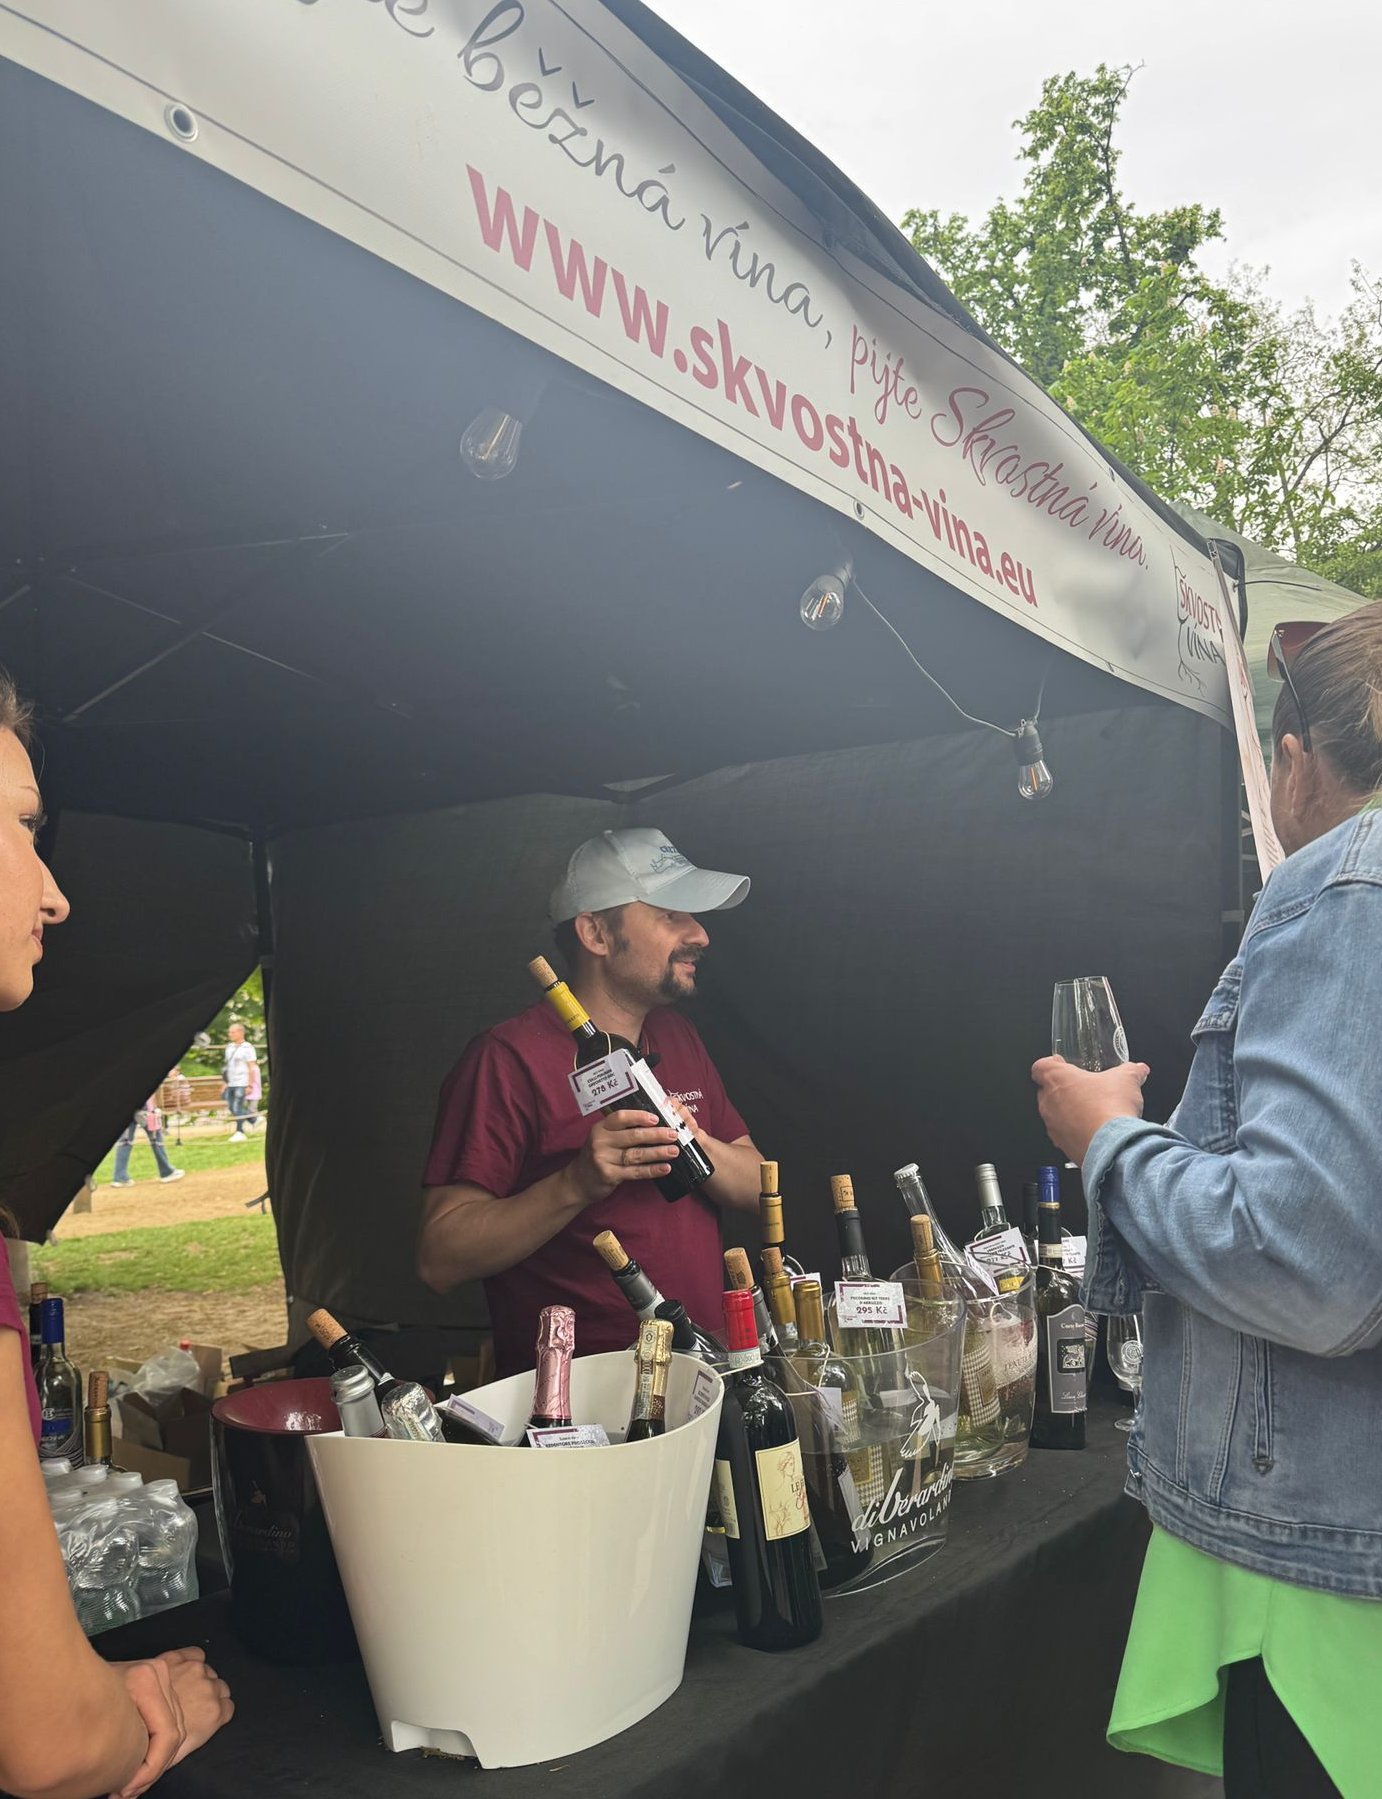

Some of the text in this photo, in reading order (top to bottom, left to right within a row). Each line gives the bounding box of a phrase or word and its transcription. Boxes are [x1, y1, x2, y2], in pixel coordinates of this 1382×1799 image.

[457, 0, 686, 231] běžná
[700, 213, 832, 349] vína,
[850, 324, 922, 425] pijte
[931, 387, 1099, 527] Skvostná
[465, 163, 1038, 607] www.skvostna-vina.eu
[607, 1079, 619, 1089] Kč
[876, 1306, 888, 1315] Kč
